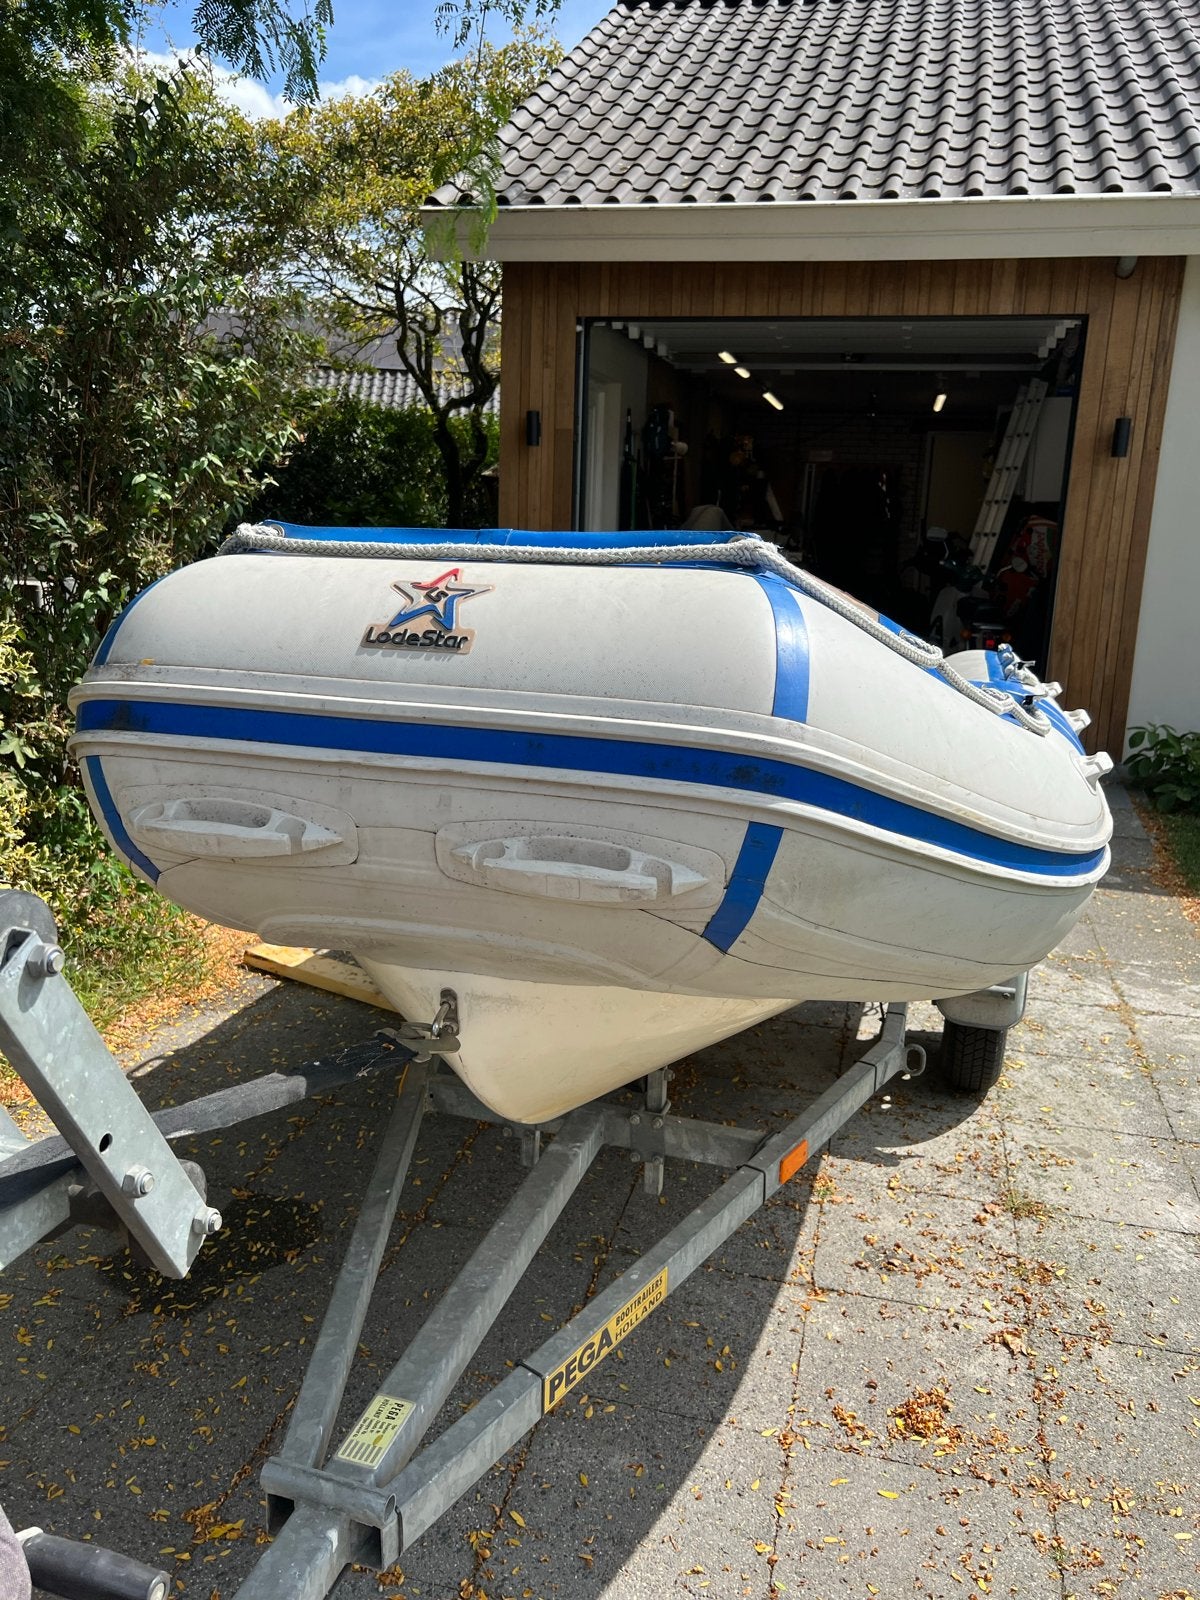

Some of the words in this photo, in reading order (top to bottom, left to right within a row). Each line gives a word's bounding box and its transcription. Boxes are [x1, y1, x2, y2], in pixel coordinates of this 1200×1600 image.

[366, 626, 468, 649] LodeStar
[615, 1291, 662, 1341] HOLLAND
[616, 1275, 663, 1326] BOOTTRAILERS
[549, 1327, 613, 1405] PEGA
[385, 1402, 404, 1420] PEGA
